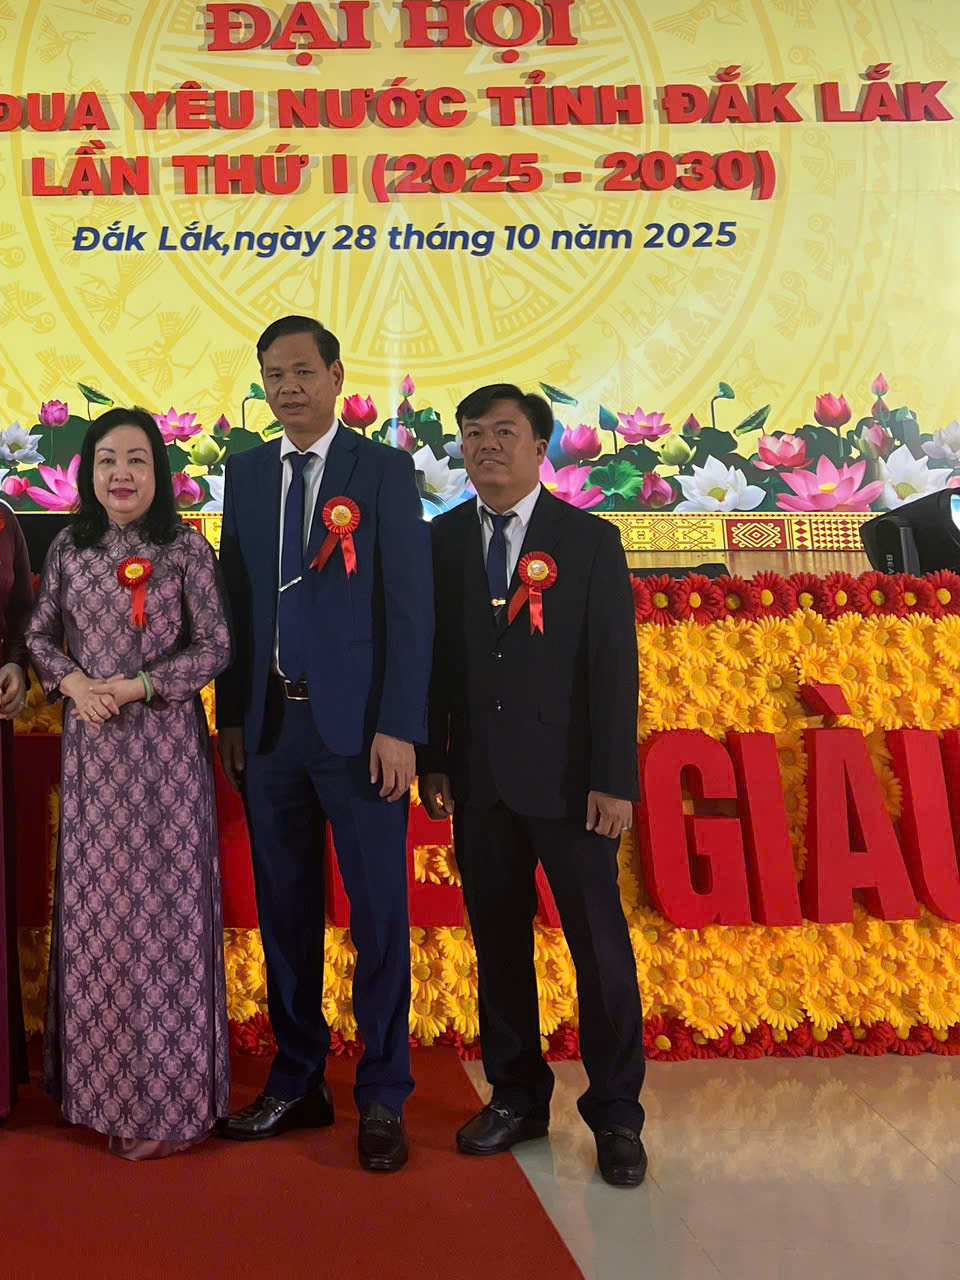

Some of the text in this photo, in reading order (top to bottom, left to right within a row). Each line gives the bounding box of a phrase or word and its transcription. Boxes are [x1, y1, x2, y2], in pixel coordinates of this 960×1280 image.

[205, 0, 372, 67] ĐẠI
[129, 80, 254, 130] YÊU
[276, 76, 468, 128] NƯỚC
[486, 70, 644, 126] TỈNH
[662, 64, 804, 123] ĐẮK
[819, 62, 954, 121] LẮK
[30, 139, 150, 197] LẦN
[172, 143, 308, 196] THỨ
[332, 154, 349, 194] I
[371, 152, 543, 203] (2025
[601, 150, 777, 200] 2030)
[72, 220, 145, 252] Đắk
[332, 225, 376, 251] 28
[387, 221, 495, 257] tháng
[506, 224, 540, 251] 10
[551, 222, 633, 250] năm
[643, 222, 737, 249] 2025
